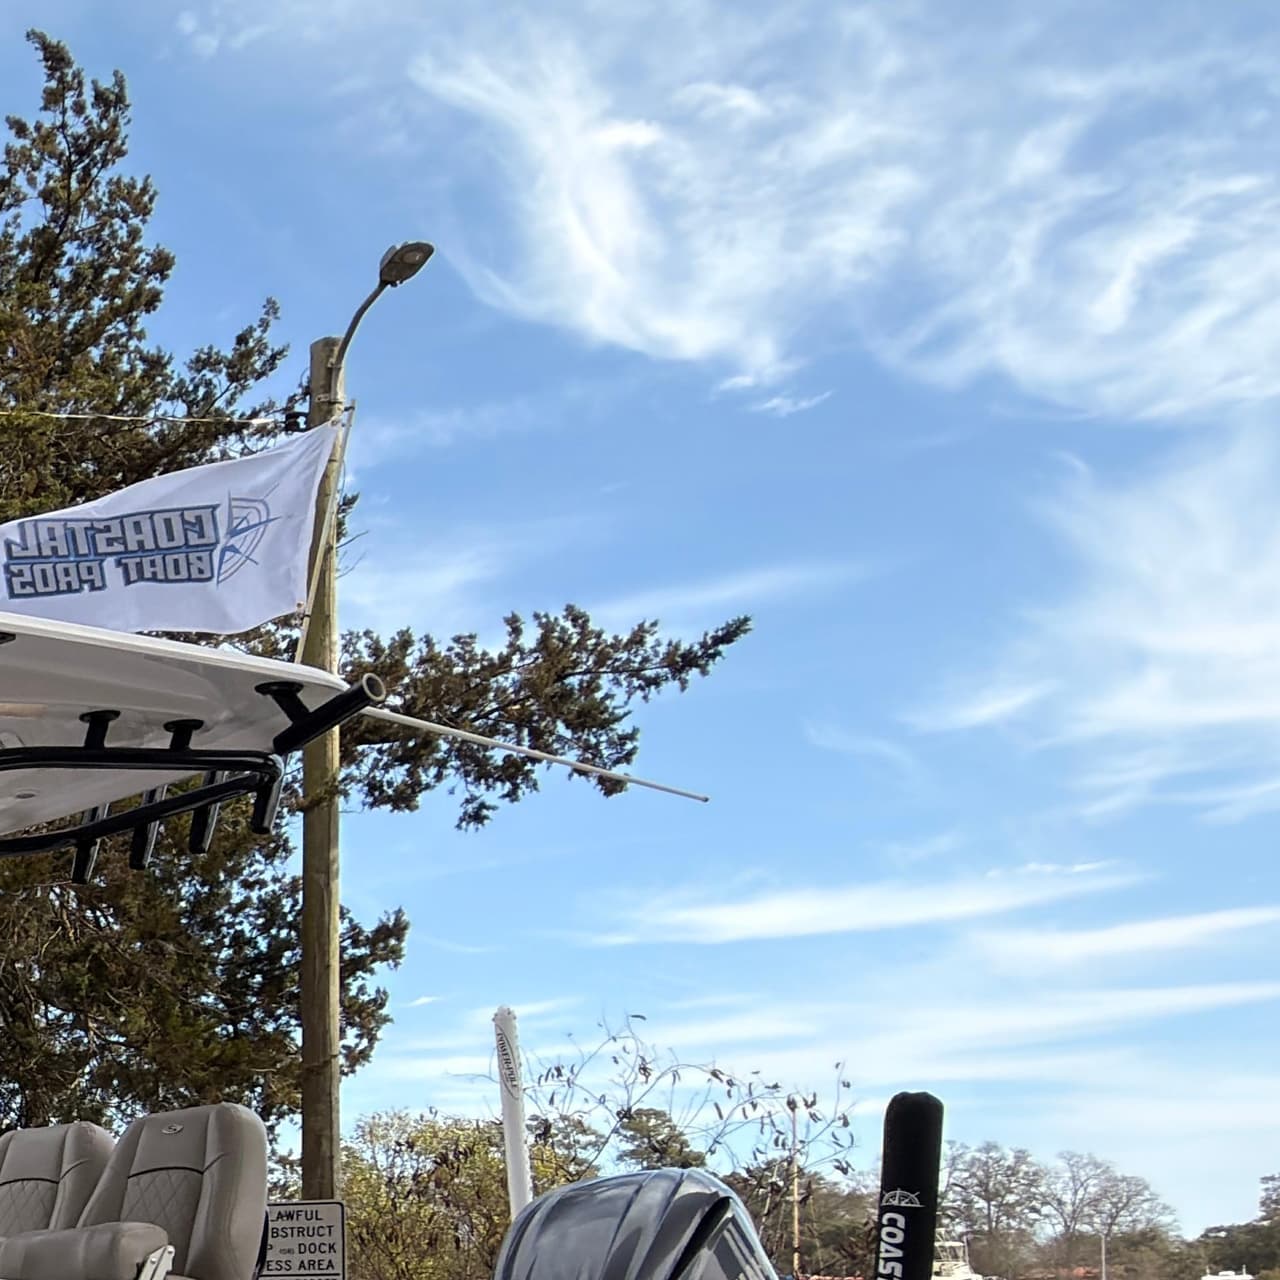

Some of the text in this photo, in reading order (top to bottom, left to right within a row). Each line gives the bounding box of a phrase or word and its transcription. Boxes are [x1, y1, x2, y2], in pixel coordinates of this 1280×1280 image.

[270, 1210, 323, 1222] AWFUL
[271, 1225, 335, 1238] BSTRUCT
[298, 1242, 337, 1255] DOCK
[266, 1259, 335, 1272] ESS AREA
